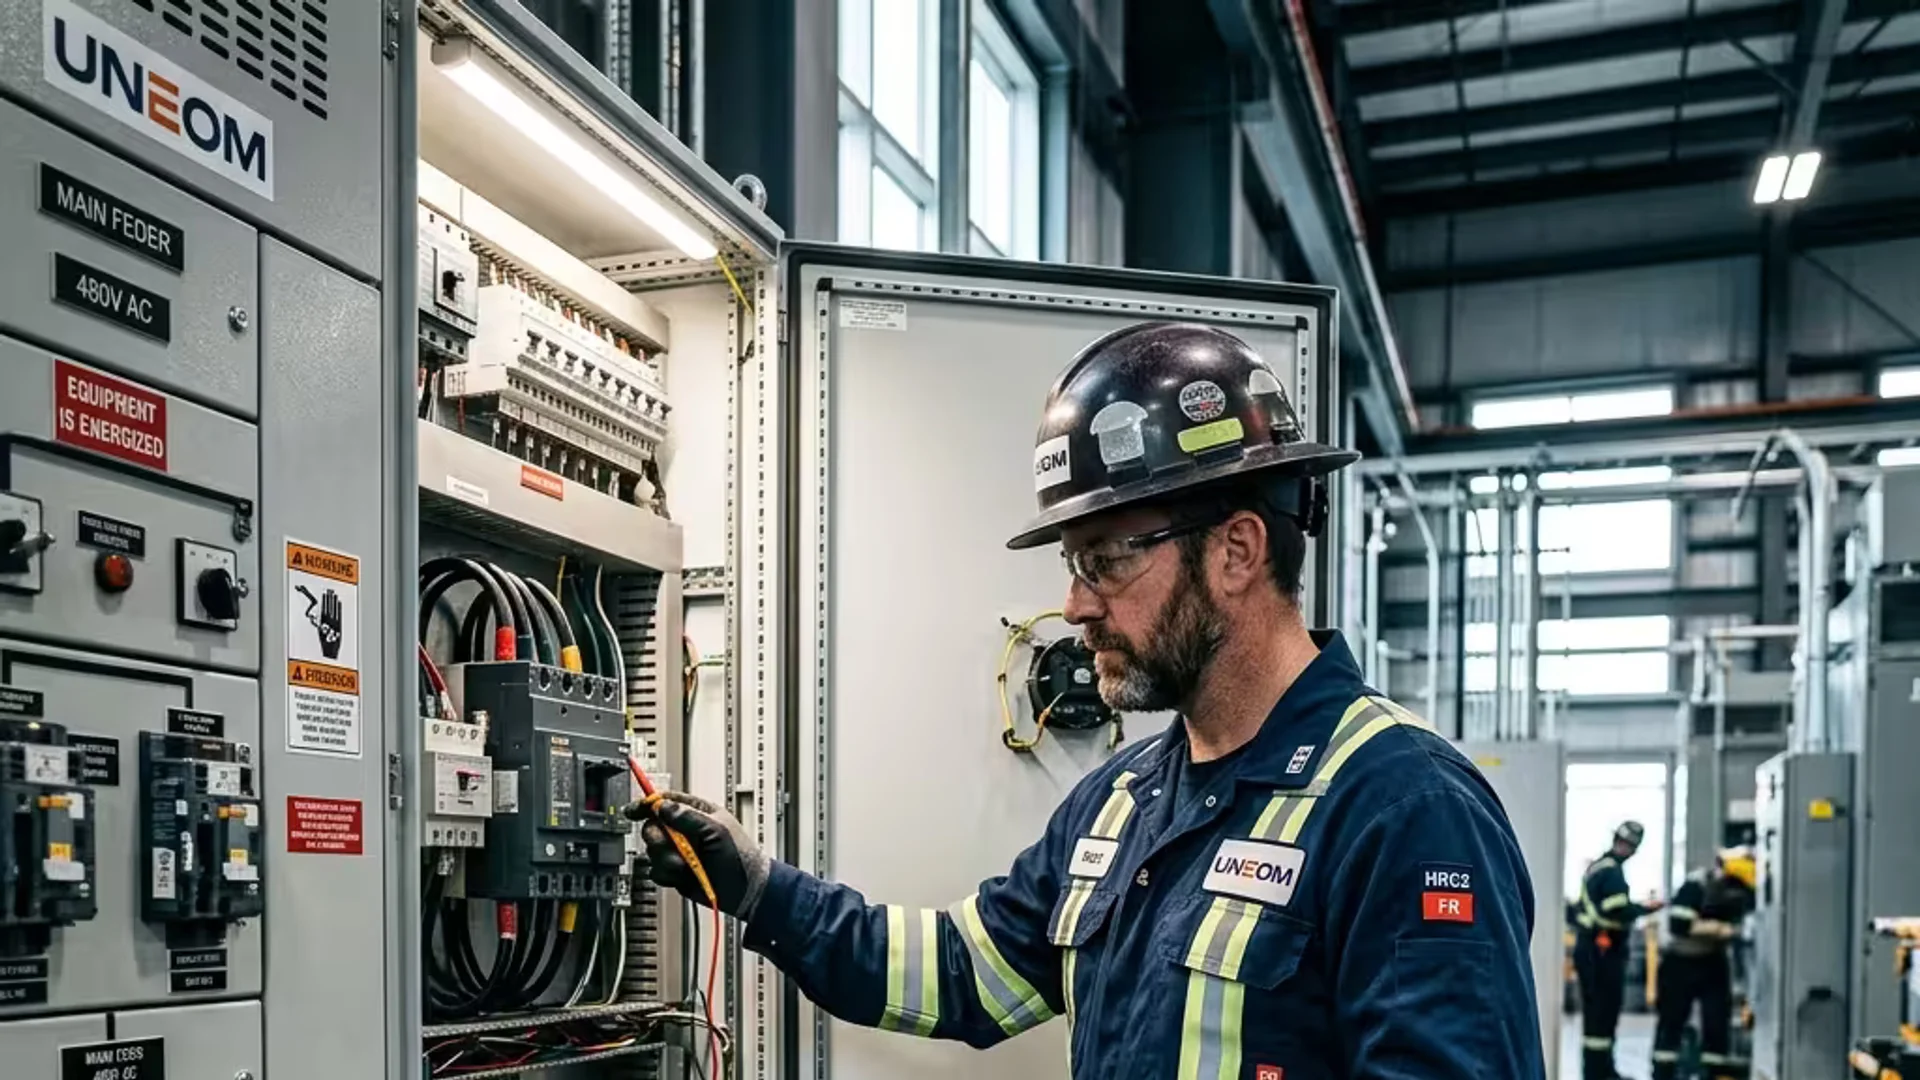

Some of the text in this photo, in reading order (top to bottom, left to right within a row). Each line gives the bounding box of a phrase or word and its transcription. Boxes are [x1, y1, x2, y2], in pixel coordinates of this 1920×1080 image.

[54, 15, 266, 182] UNEOM
[57, 181, 172, 256] MAIN FEDER
[76, 274, 153, 324] 480V AC
[60, 407, 164, 459] IS ENERGIZED
[1214, 856, 1294, 887] UNEOM
[1424, 870, 1471, 889] HRC2
[1438, 898, 1460, 915] FR
